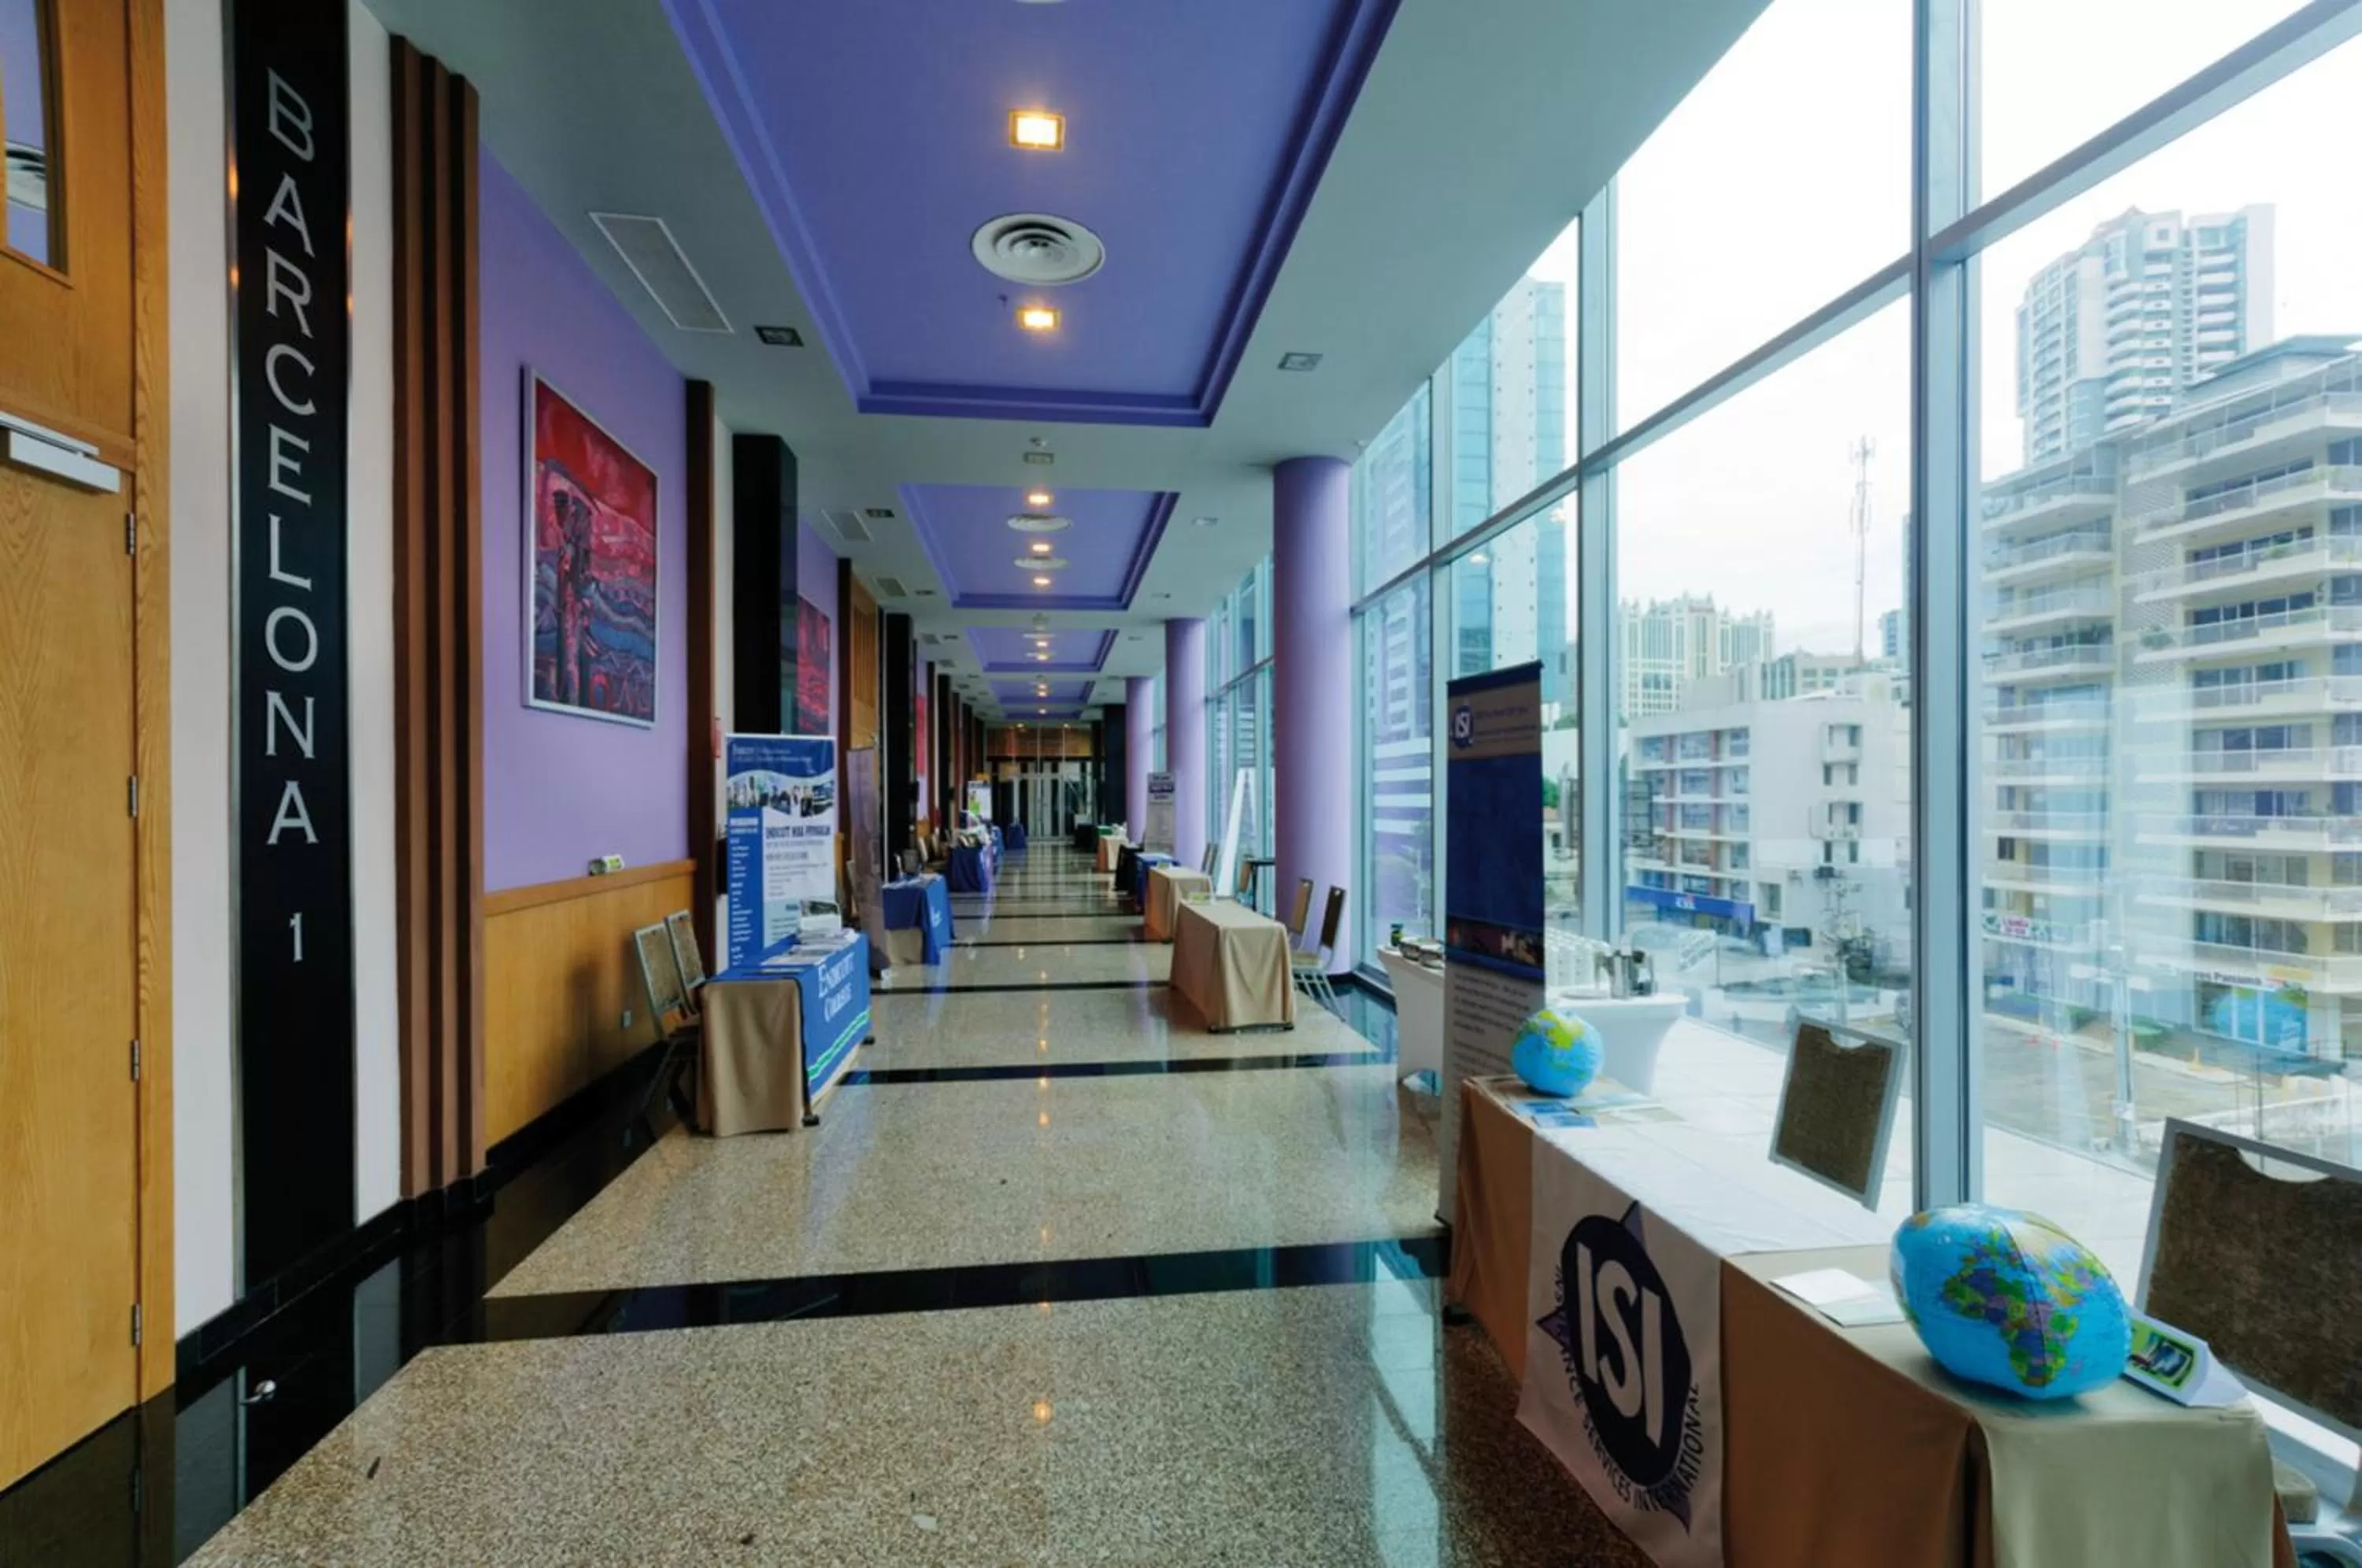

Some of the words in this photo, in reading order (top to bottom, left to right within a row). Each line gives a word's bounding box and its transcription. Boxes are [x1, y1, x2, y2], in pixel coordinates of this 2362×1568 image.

[264, 66, 319, 845] BARCELONA
[290, 912, 303, 963] 1
[1576, 1241, 1661, 1448] ISI
